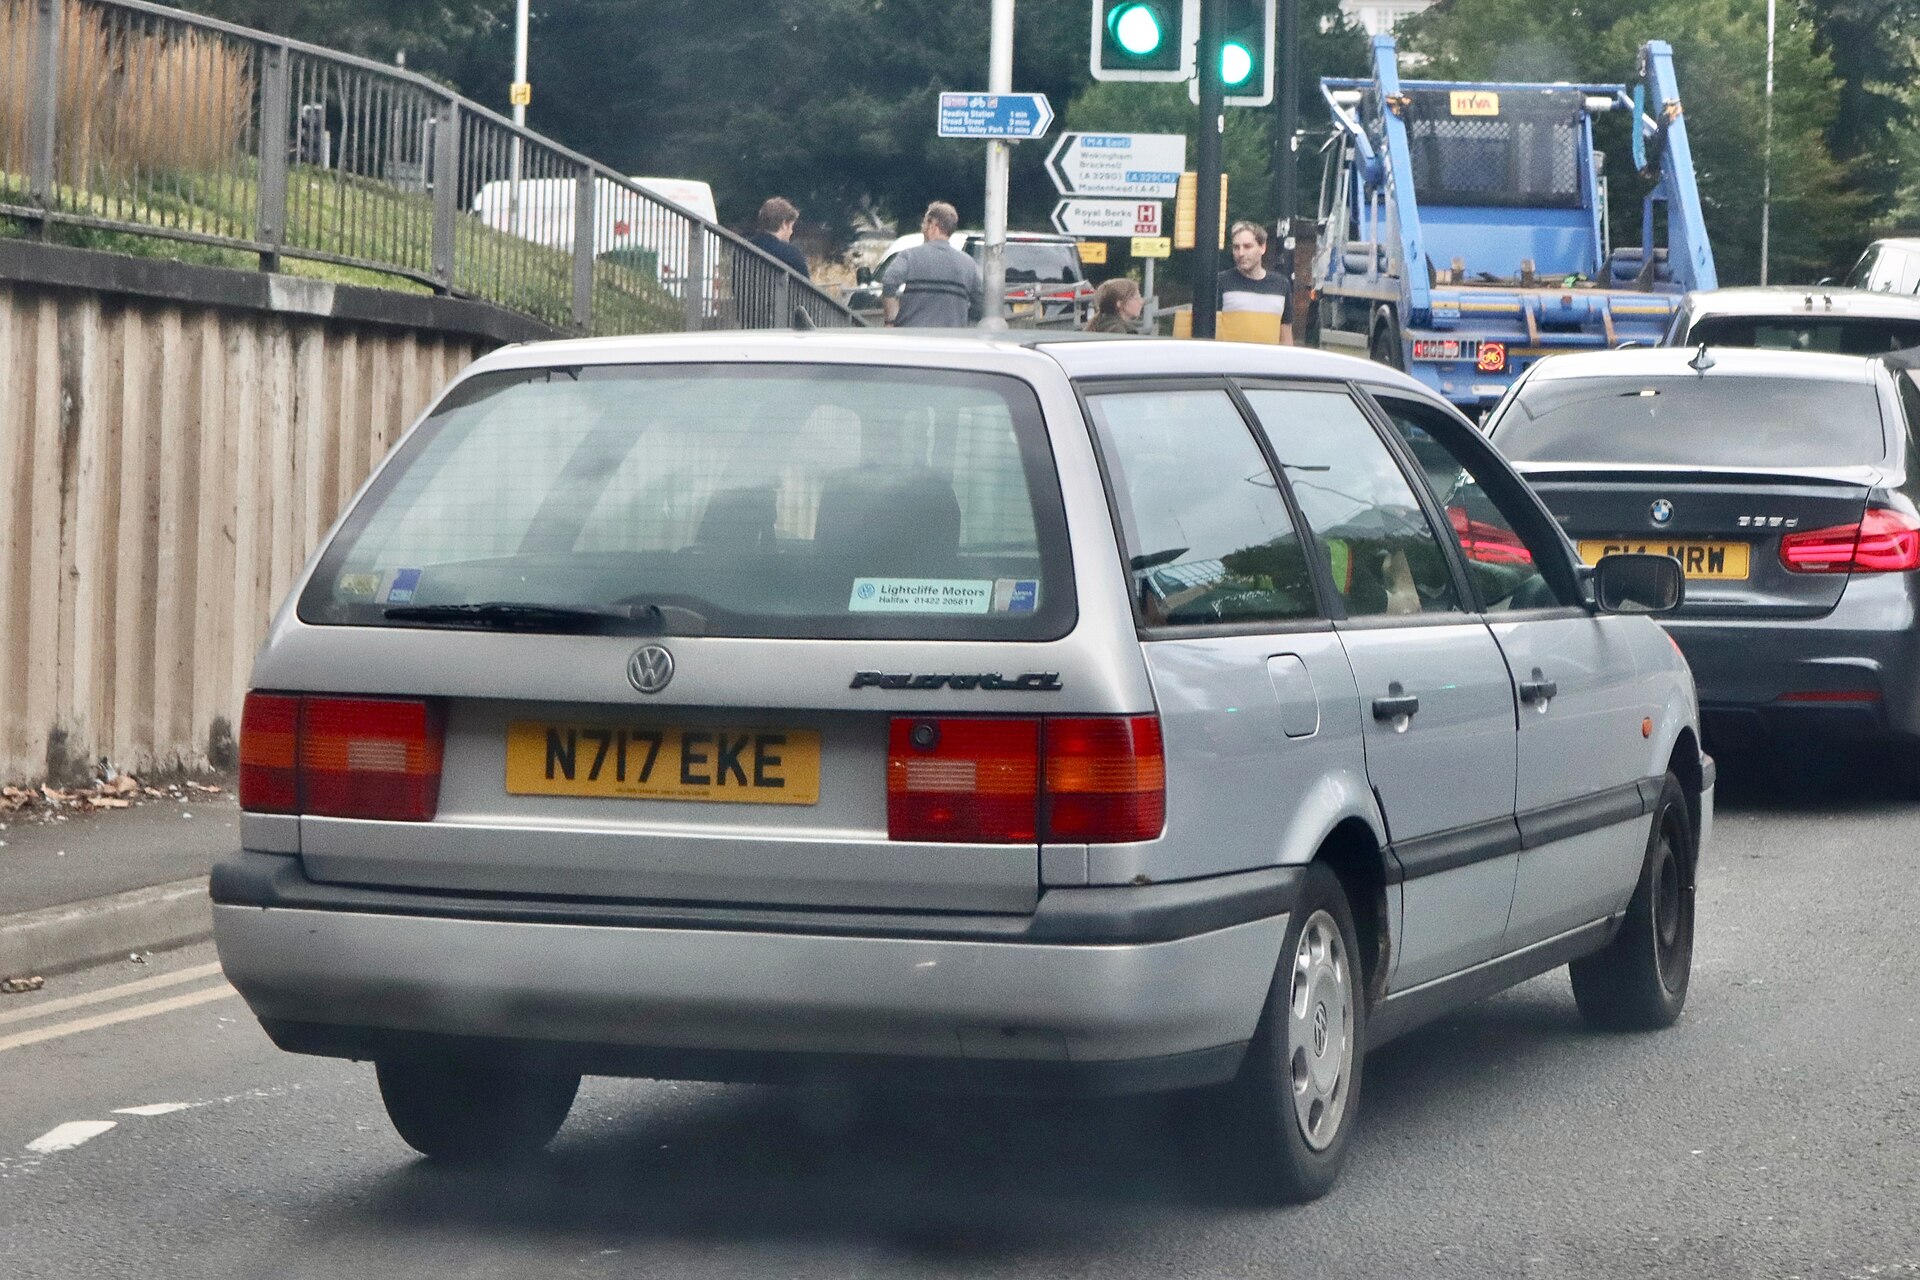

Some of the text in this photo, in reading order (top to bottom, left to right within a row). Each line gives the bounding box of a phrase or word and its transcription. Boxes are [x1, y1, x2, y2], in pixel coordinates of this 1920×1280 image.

[1457, 94, 1491, 109] HYVA
[943, 110, 969, 119] Reading
[970, 110, 995, 118] Station
[943, 118, 962, 126] Broad
[964, 117, 985, 126] Street
[943, 126, 966, 134] Thames
[968, 126, 987, 135] Valley
[988, 126, 1004, 134] Park
[1081, 152, 1132, 161] Wokingham
[1075, 208, 1132, 218] Royal Berks
[1083, 219, 1123, 227] Hospital
[881, 584, 985, 597] Lightcliffe Motors
[545, 728, 787, 788] N717 EKE
